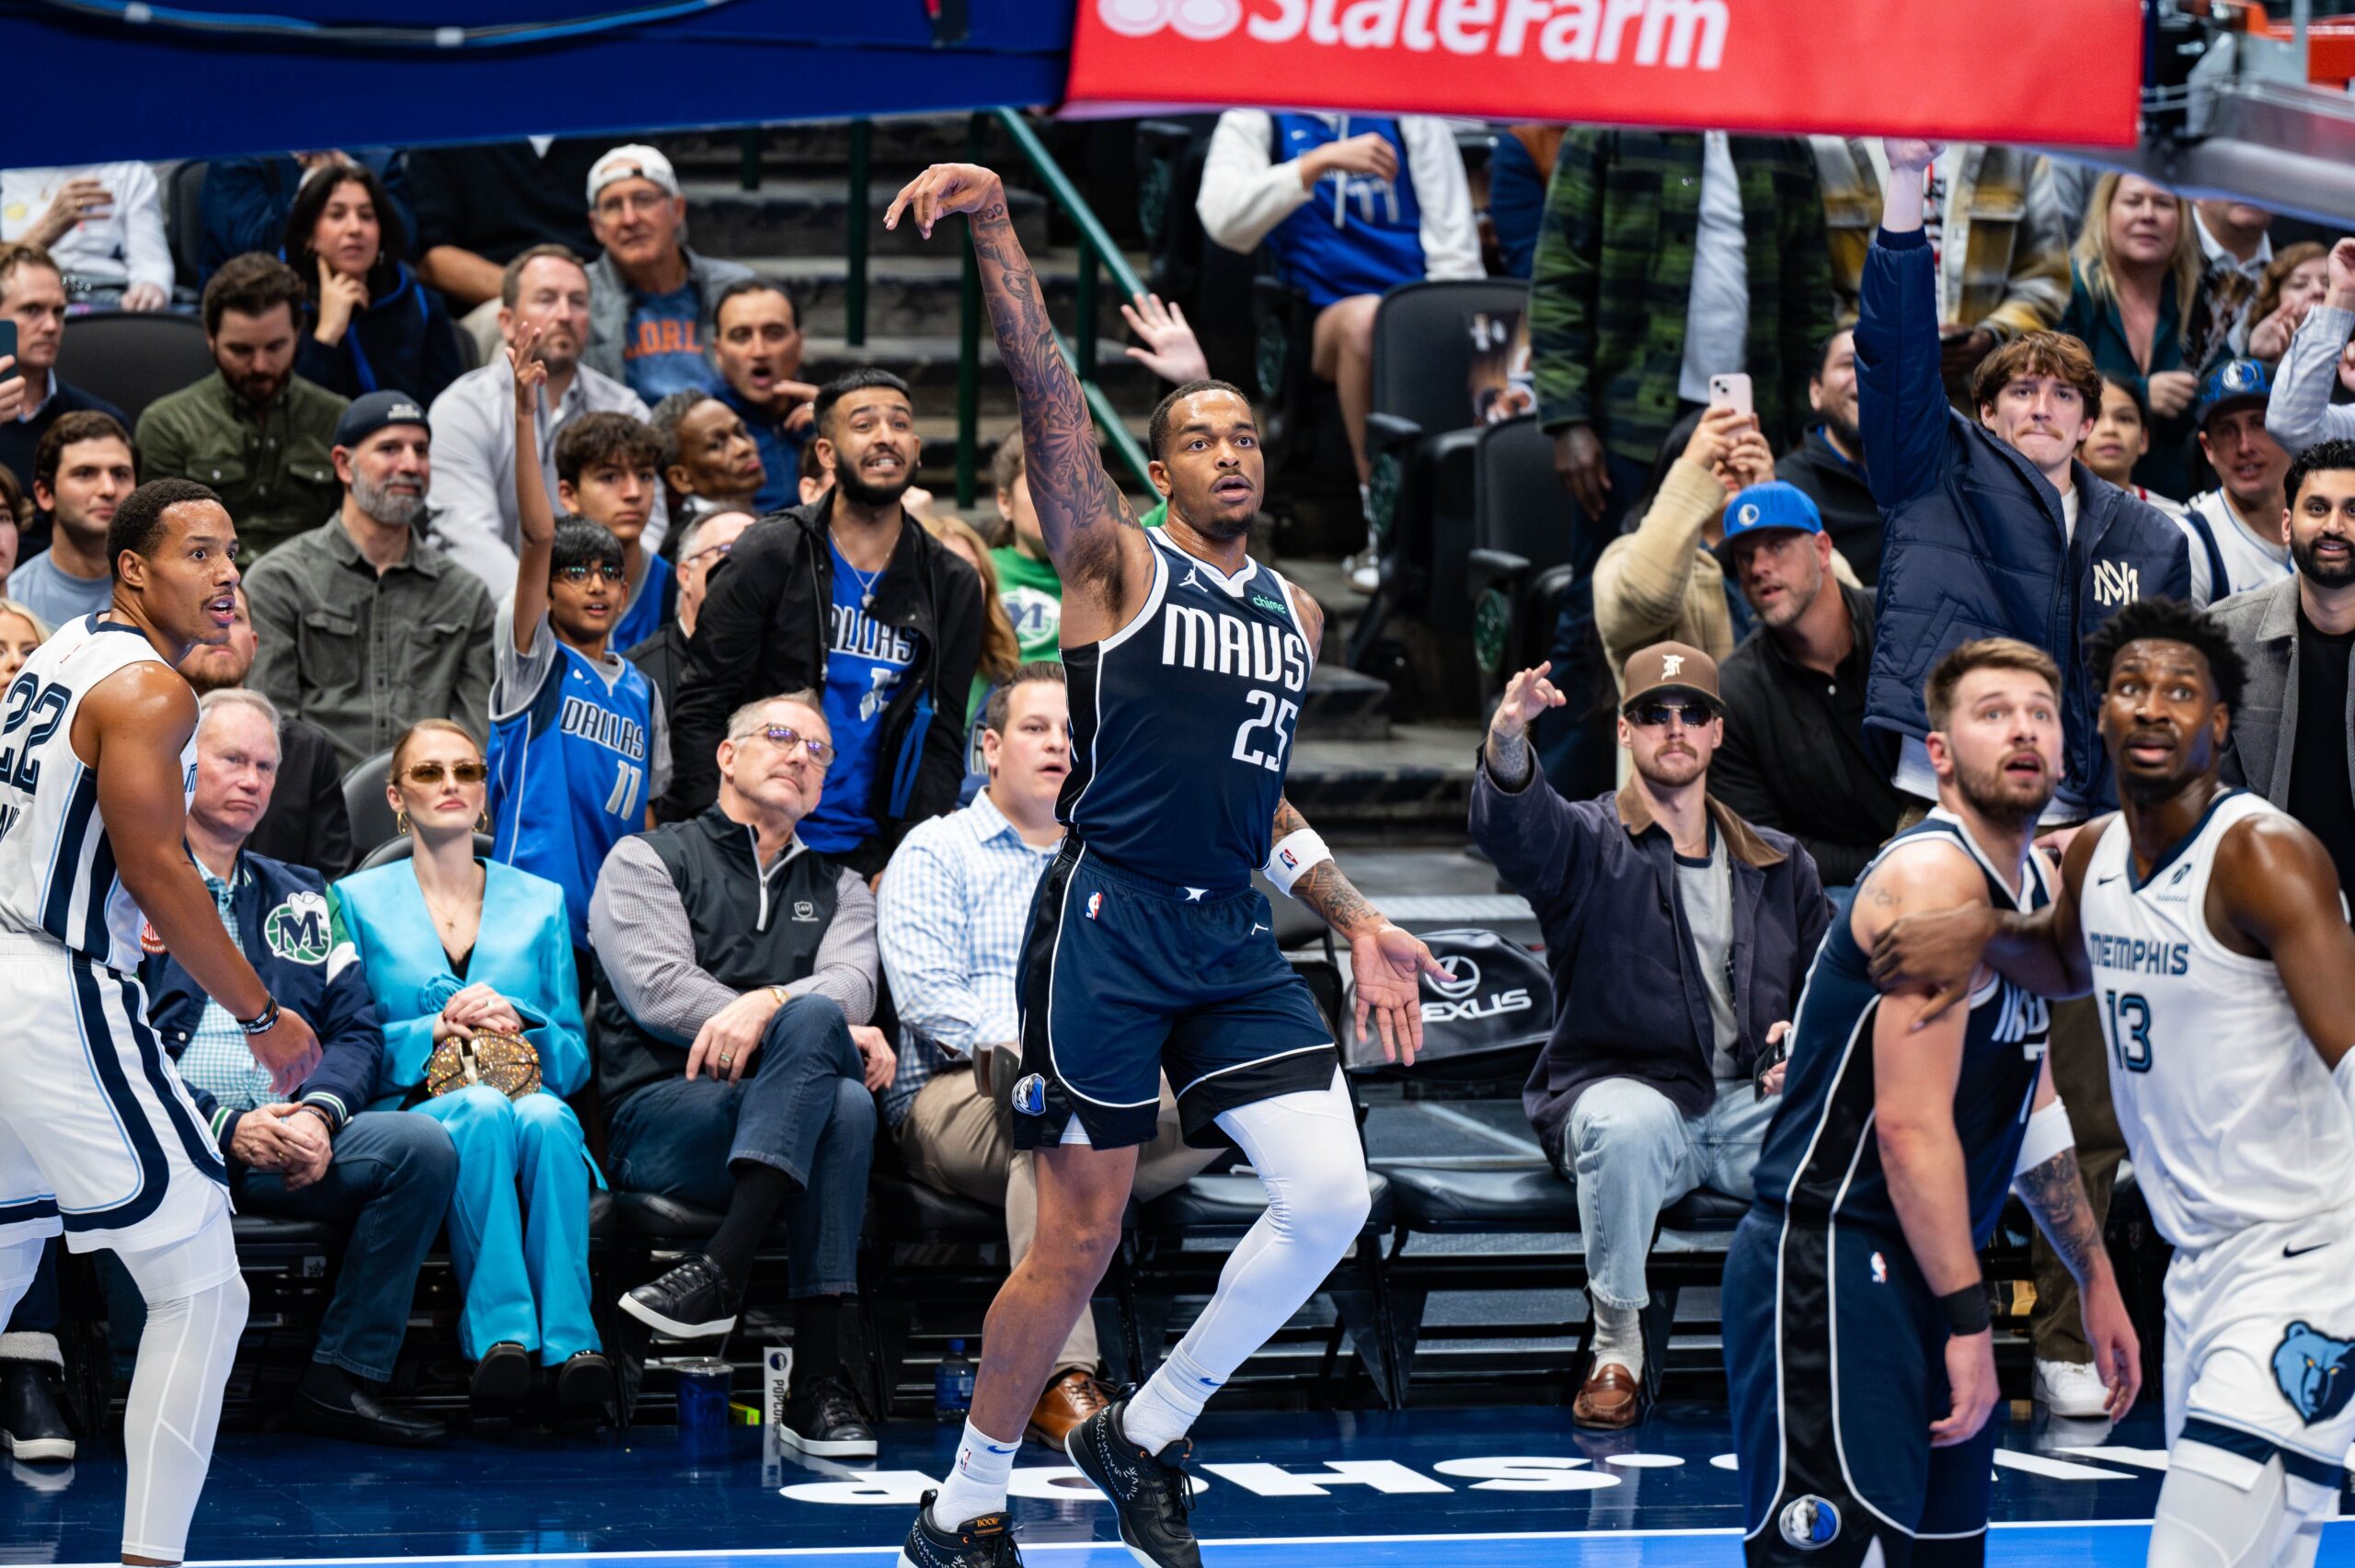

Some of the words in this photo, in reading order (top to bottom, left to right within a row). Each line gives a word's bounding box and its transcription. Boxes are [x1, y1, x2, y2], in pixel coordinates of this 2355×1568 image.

[1252, 595, 1287, 614] chime
[1162, 603, 1304, 692] MAVS
[560, 695, 645, 761] DALLAS
[1232, 690, 1298, 772] 25
[604, 760, 642, 821] 11
[276, 910, 325, 955] M
[2089, 933, 2189, 975] MEMPHIS
[1421, 989, 1533, 1023] EXUS
[2106, 990, 2153, 1074] 13
